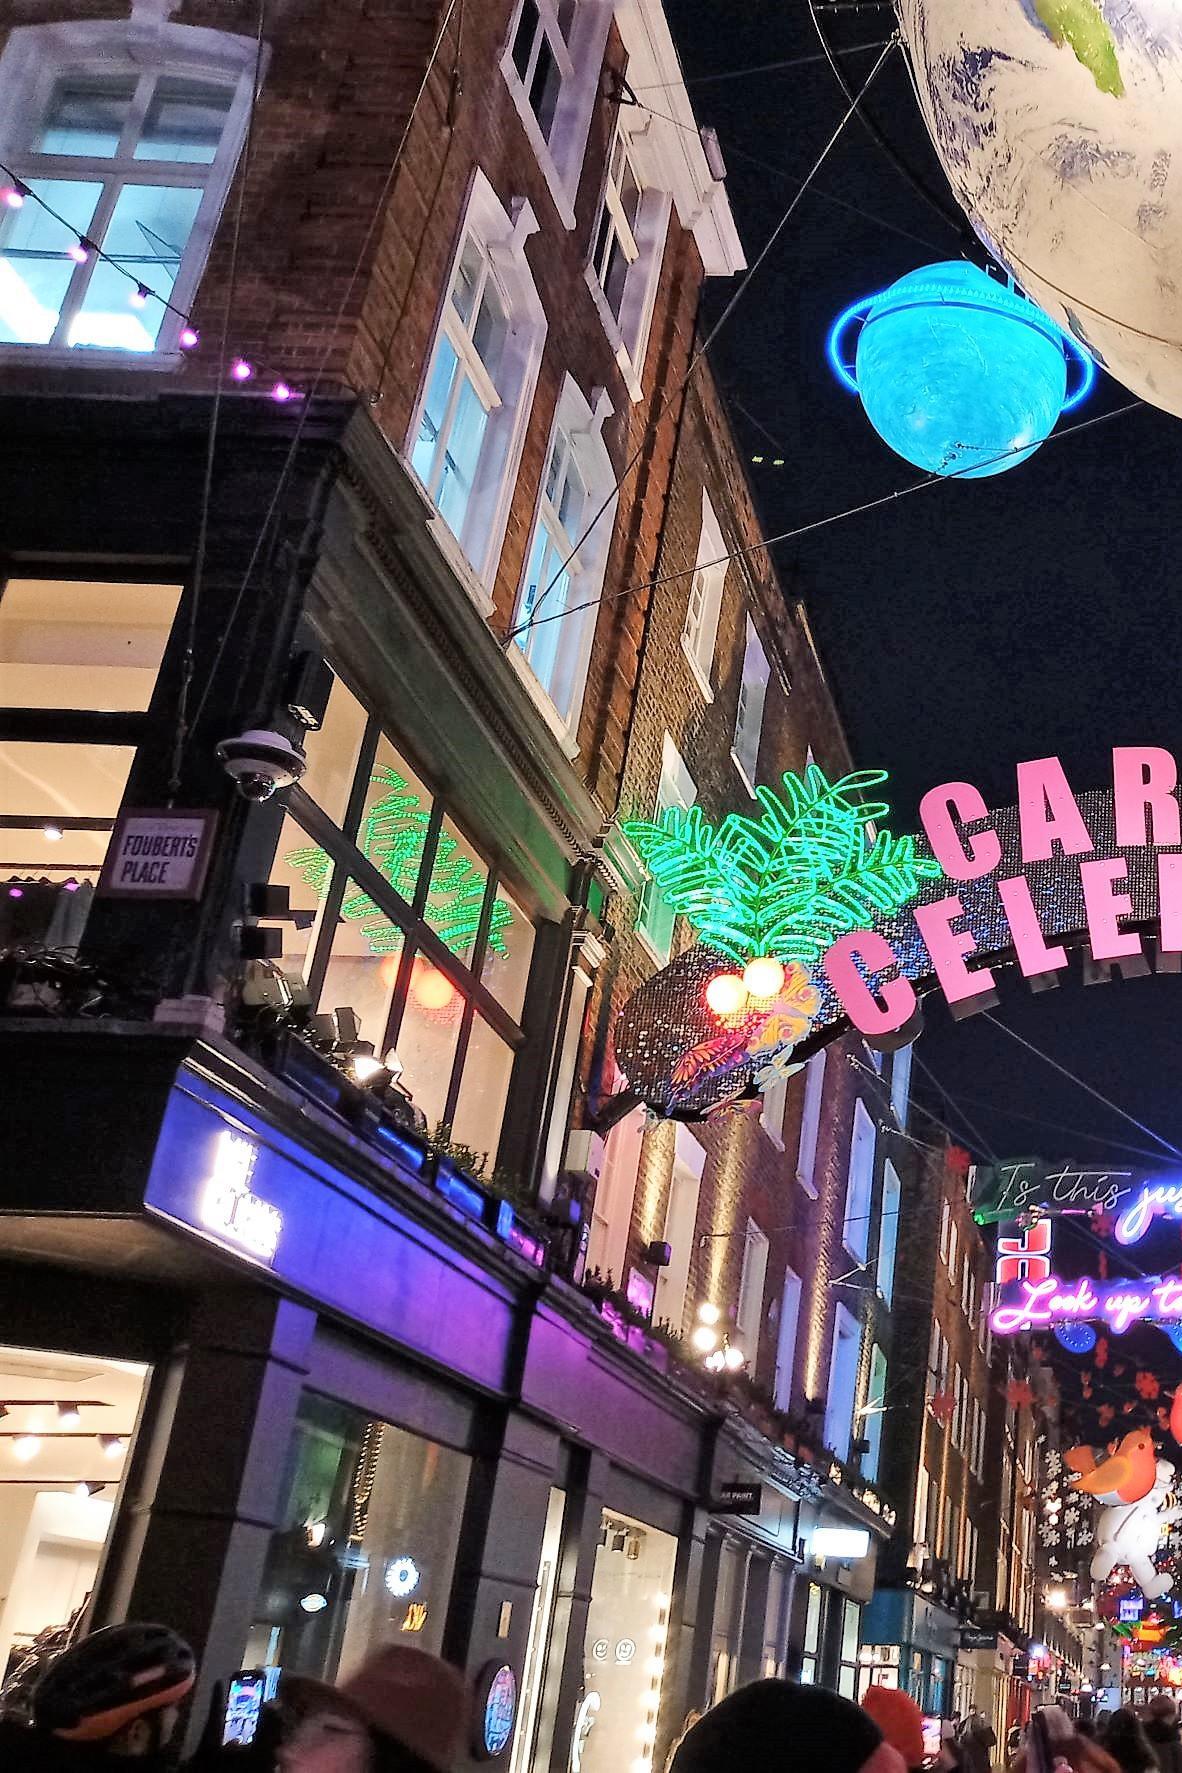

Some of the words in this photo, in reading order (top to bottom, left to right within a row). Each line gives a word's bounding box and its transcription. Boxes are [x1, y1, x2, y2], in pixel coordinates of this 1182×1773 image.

[122, 834, 198, 857] FOUBERT'S
[120, 861, 170, 883] PLACE
[998, 1163, 1040, 1209] Is
[1045, 1165, 1132, 1209] this
[990, 1278, 1099, 1333] Look
[1105, 1293, 1150, 1332] up
